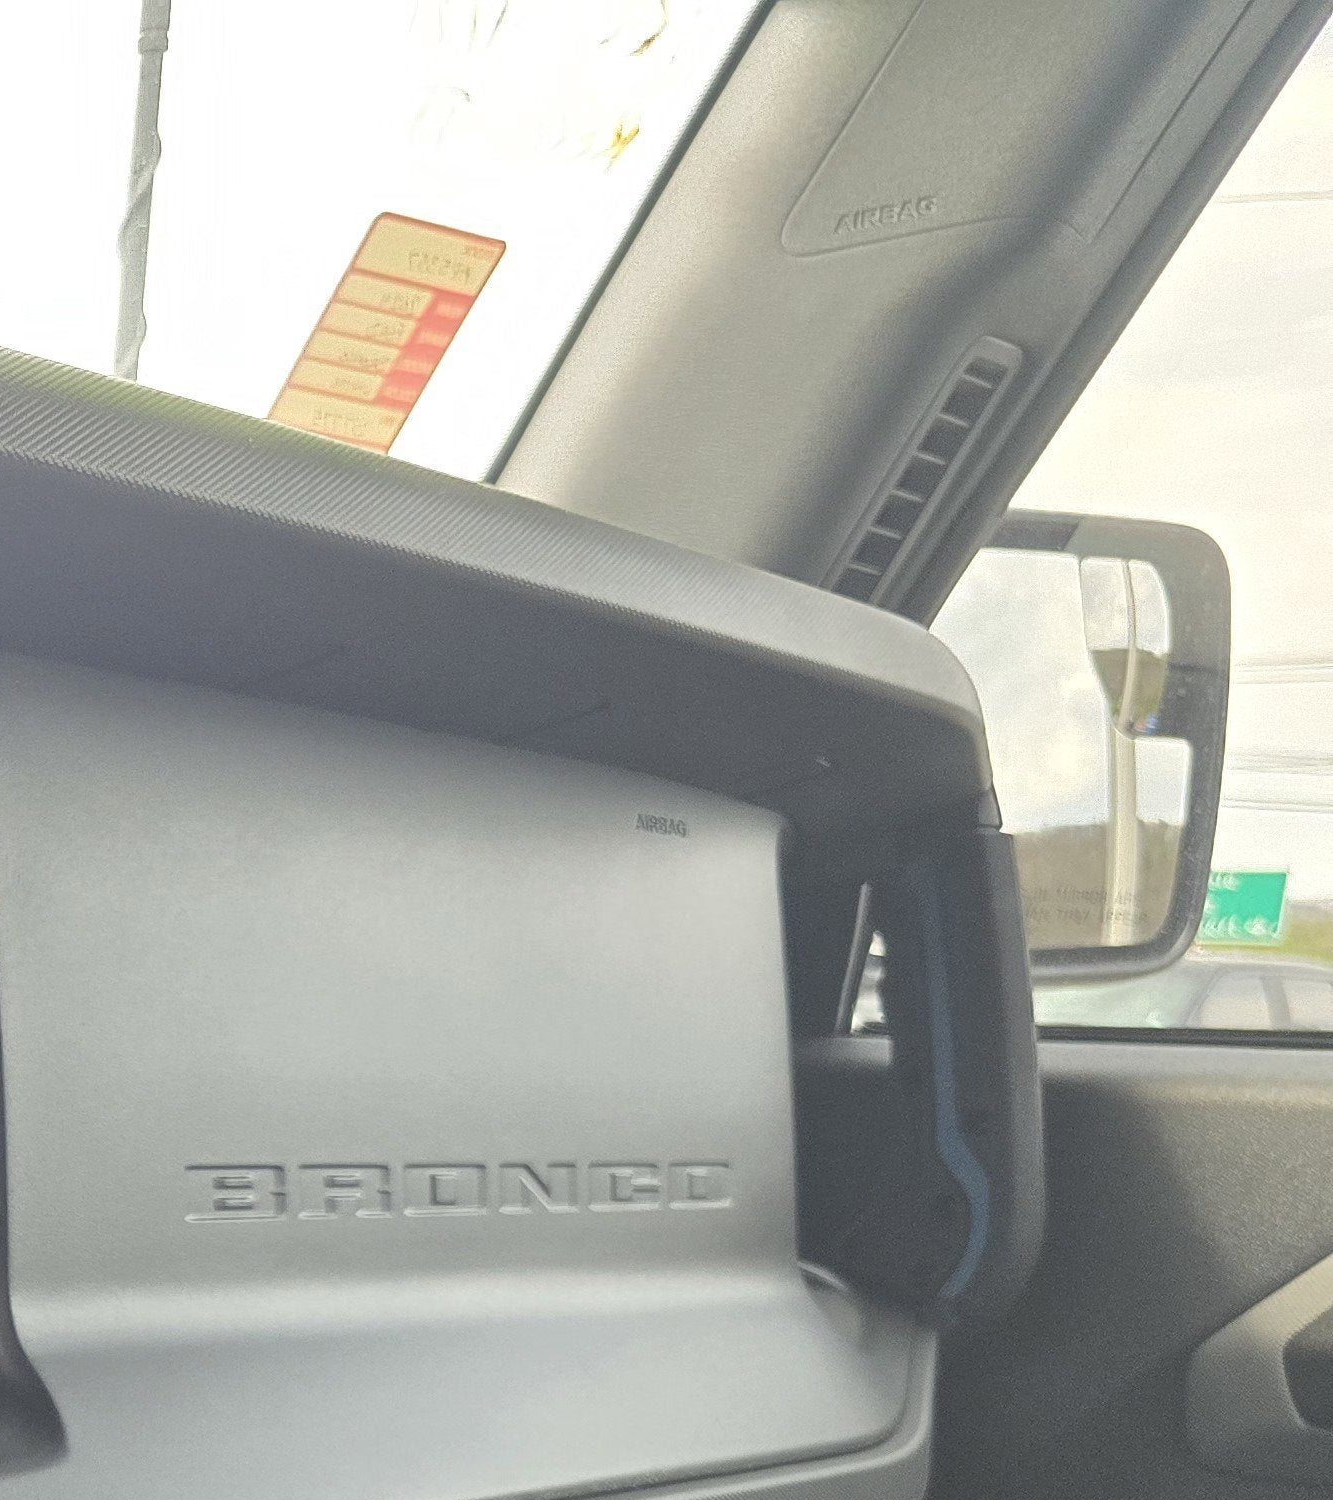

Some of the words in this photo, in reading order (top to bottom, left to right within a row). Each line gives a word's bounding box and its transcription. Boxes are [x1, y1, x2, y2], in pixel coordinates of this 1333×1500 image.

[833, 195, 938, 234] AIRBAG
[635, 812, 688, 838] AIRBAG
[183, 1162, 733, 1223] BRONCO
